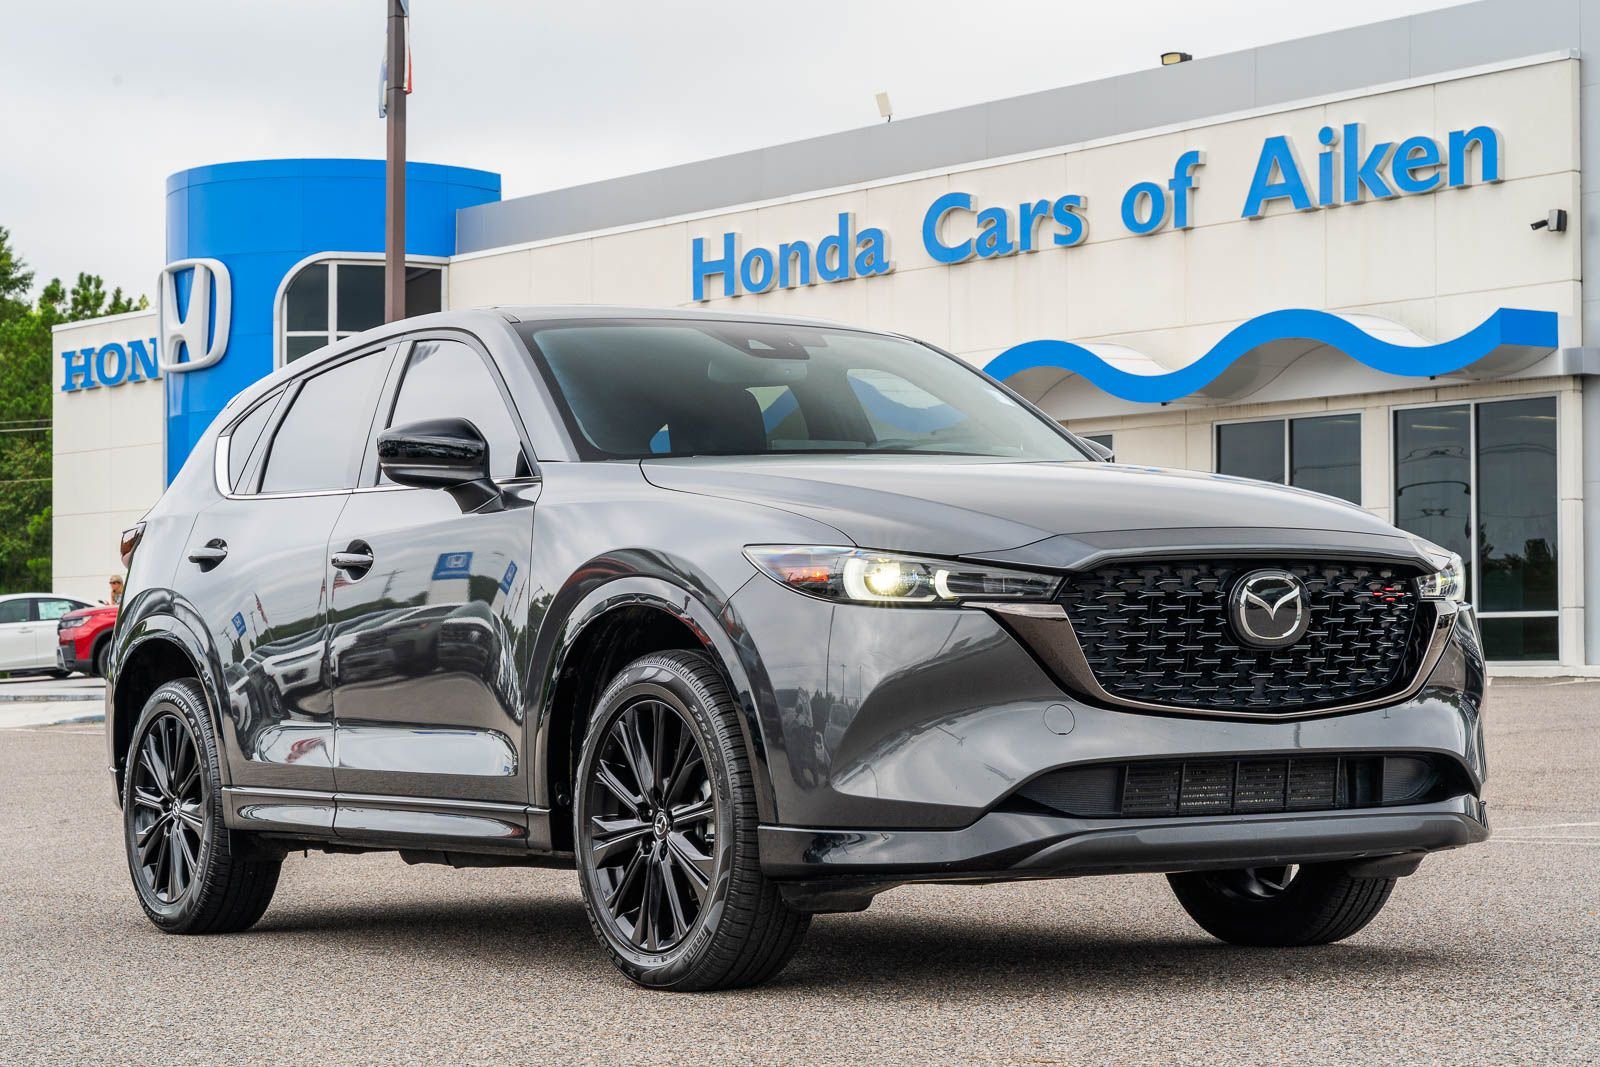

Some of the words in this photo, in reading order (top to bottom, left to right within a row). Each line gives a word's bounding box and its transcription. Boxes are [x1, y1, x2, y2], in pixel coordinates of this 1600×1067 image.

[692, 212, 895, 301] Honda
[922, 192, 1088, 264] Cars
[1121, 150, 1205, 235] of
[1241, 122, 1504, 219] Aiken
[61, 337, 160, 393] HON
